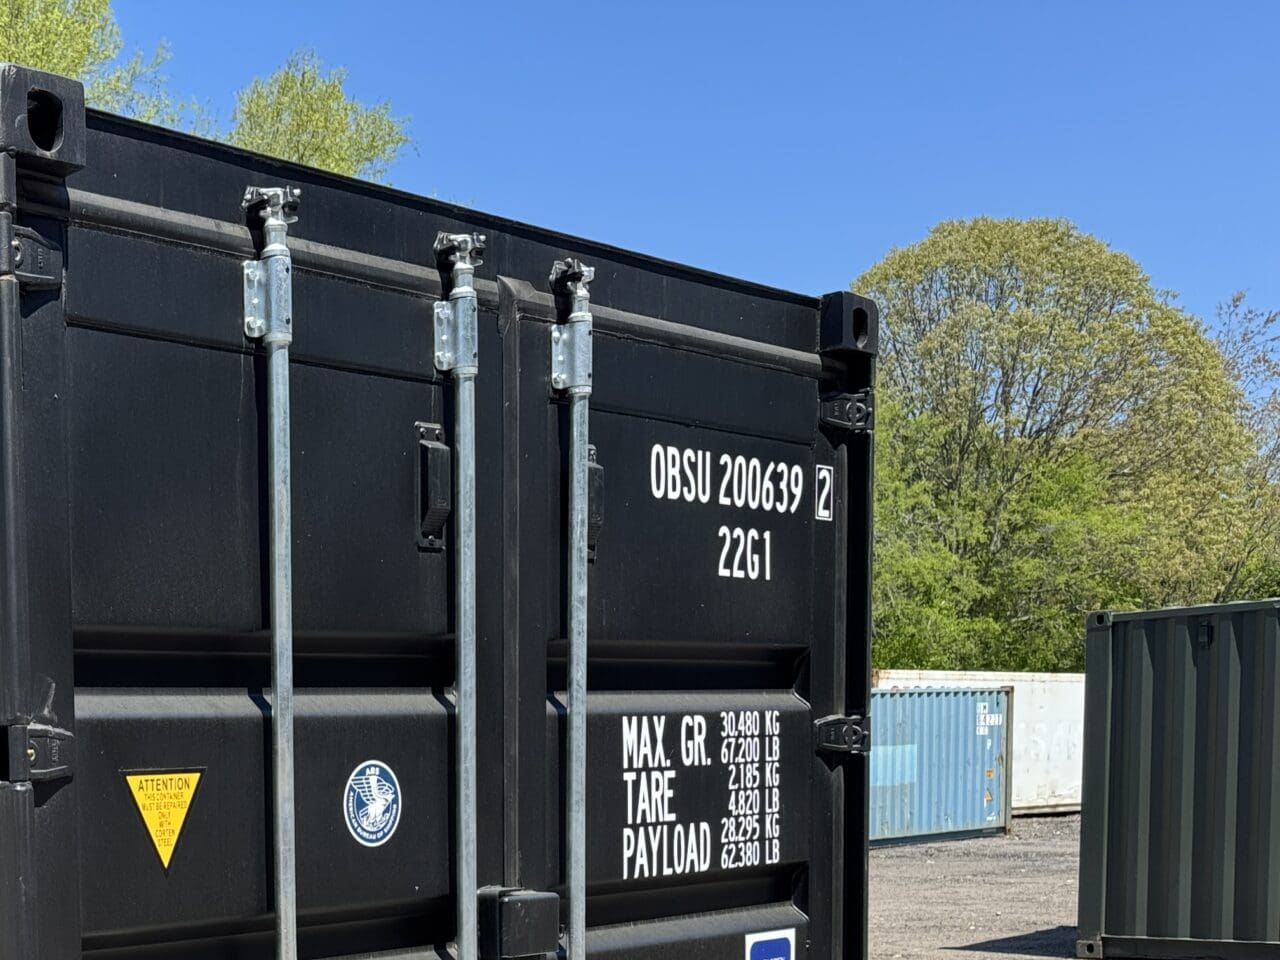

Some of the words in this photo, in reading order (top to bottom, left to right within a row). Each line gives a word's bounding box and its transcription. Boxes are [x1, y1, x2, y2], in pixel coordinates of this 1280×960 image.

[651, 444, 711, 504] OBSU
[719, 453, 803, 514] 200639
[818, 468, 832, 518] 2
[718, 525, 771, 581] 22G1
[765, 710, 780, 736] KG
[622, 715, 671, 769] MAX.
[680, 714, 712, 767] GR.
[765, 736, 780, 762] LB
[138, 777, 190, 792] ATTENTION
[765, 762, 780, 787] KG
[623, 770, 676, 825] TARE
[765, 788, 780, 813] LB
[765, 813, 780, 839] KG
[623, 821, 711, 880] PAYLOAD
[765, 839, 780, 865] LB
